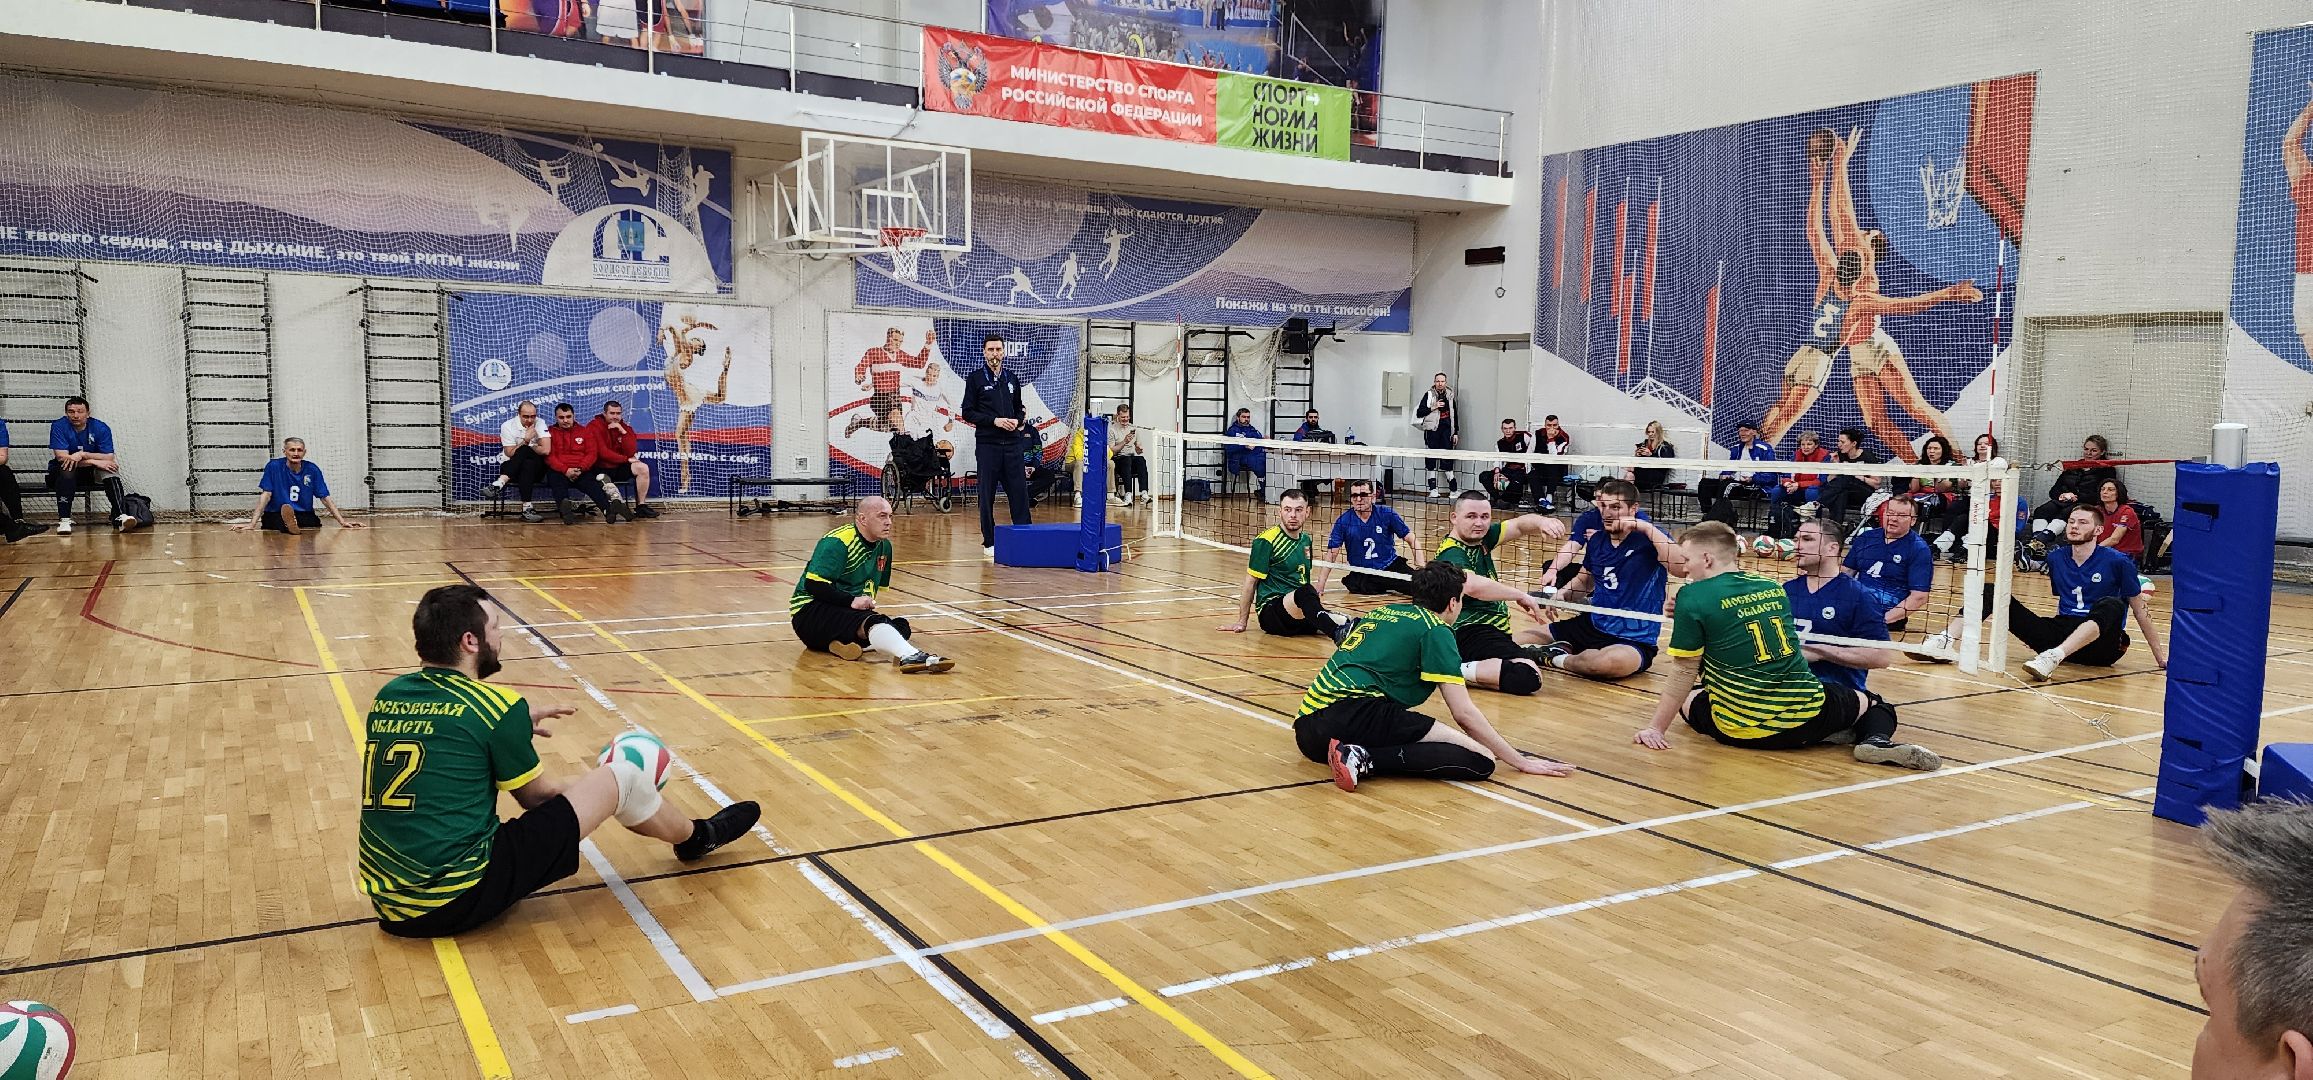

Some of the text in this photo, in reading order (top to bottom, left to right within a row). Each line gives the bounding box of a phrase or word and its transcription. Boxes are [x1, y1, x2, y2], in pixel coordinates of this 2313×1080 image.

[1010, 65, 1195, 105] МИНИСТЕРСТВО СПОРТА
[1253, 82, 1308, 107] СПОРТ
[1001, 87, 1203, 127] РОССИЙСКОЙ ФЕДЕРАЦИИ
[1252, 104, 1318, 131] НОРМА
[1252, 127, 1318, 153] ЖИЗНИ
[1113, 206, 1133, 216] как
[1137, 209, 1183, 221] сдаются
[1186, 214, 1223, 225] другие
[25, 231, 93, 244] твоего
[100, 235, 175, 250] сердца,
[180, 240, 224, 252] твоё
[230, 241, 331, 261] ДЫХАНИЕ,
[336, 250, 364, 261] это
[369, 252, 410, 264] твой
[415, 252, 463, 267] РИТМ
[468, 259, 520, 271] жизни
[1216, 296, 1391, 317] Покажи на что ты способен!
[464, 410, 497, 425] Будь
[575, 384, 610, 397] живи
[612, 380, 666, 394] спортом!
[672, 452, 717, 461] начать
[729, 453, 758, 463] себя
[289, 485, 300, 502] 6
[1363, 538, 1379, 560] 2
[1602, 567, 1619, 590] 5
[1866, 561, 1883, 578] 4
[2071, 586, 2090, 613] 1
[1339, 622, 1377, 652] 6
[1745, 615, 1795, 665] 11
[372, 719, 434, 735] ОБЛАСТЬ
[362, 739, 426, 812] 12
